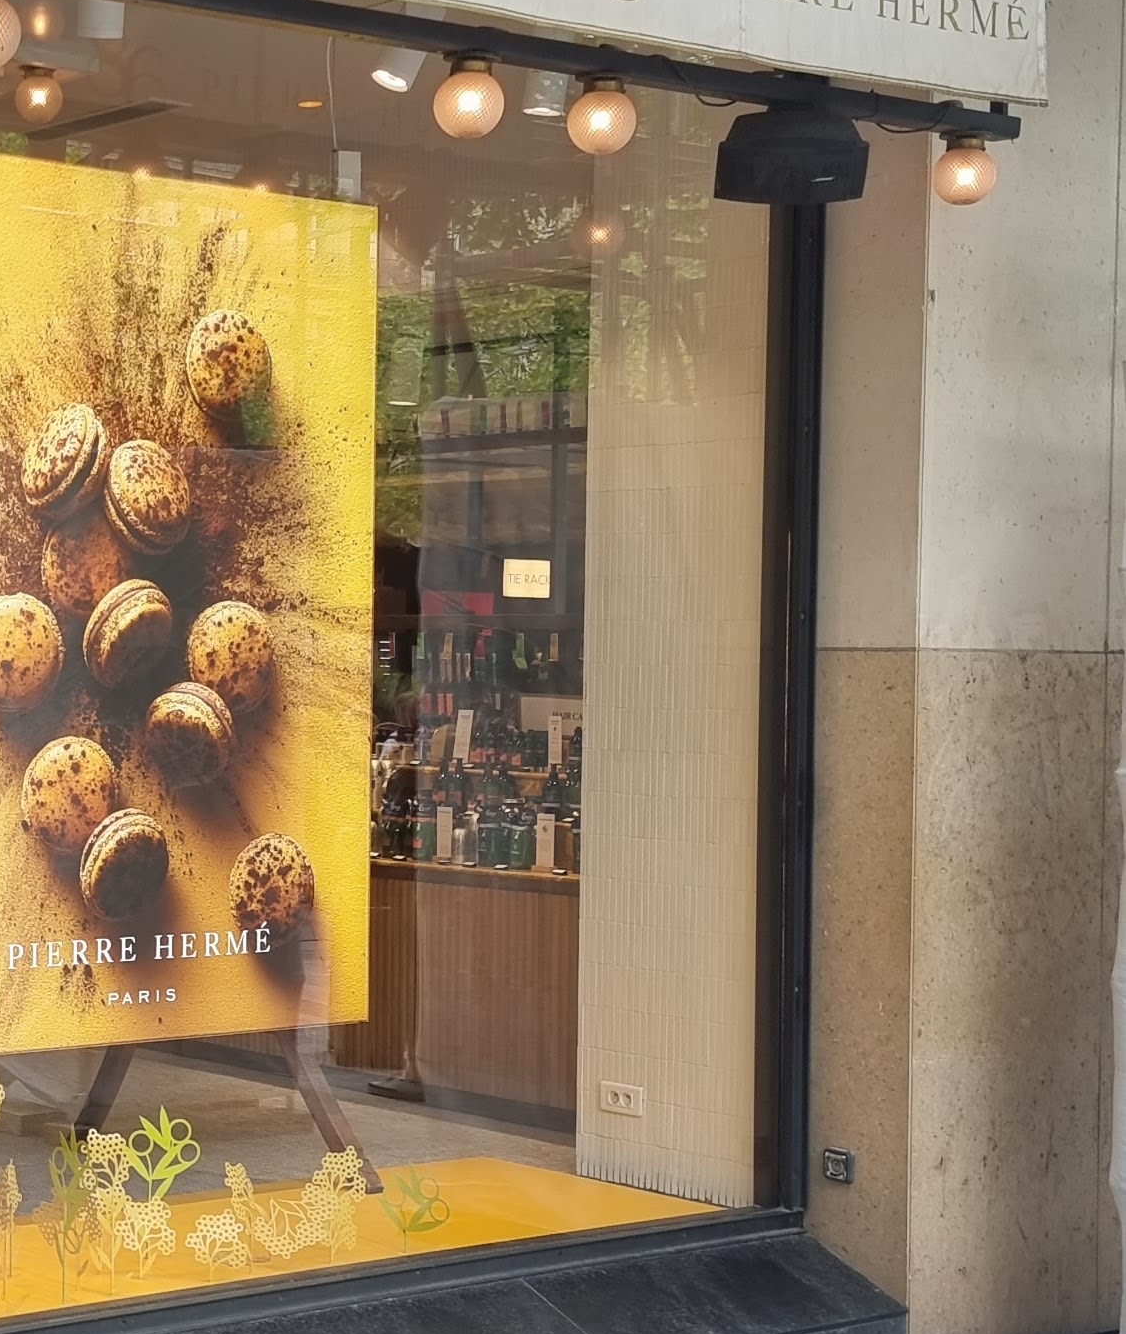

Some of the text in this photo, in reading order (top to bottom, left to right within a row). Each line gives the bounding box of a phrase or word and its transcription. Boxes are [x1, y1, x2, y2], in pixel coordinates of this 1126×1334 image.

[6, 920, 273, 972] PIERRE HERMÉ
[107, 988, 178, 1007] PARIS
